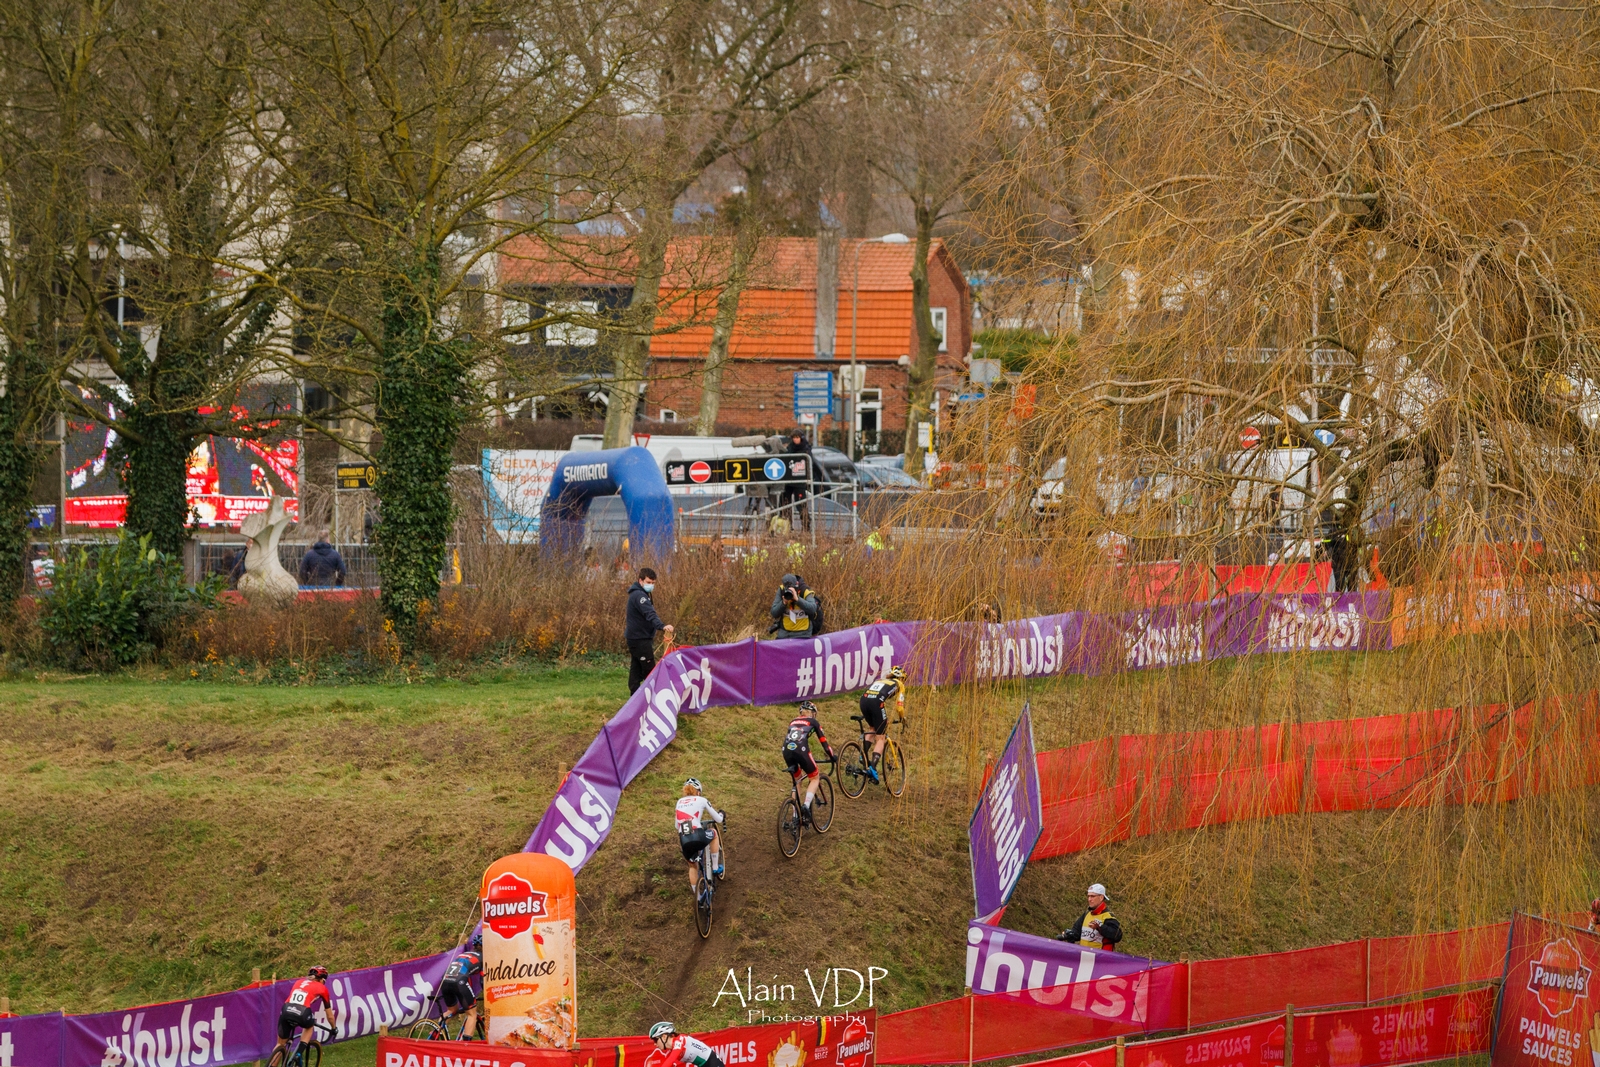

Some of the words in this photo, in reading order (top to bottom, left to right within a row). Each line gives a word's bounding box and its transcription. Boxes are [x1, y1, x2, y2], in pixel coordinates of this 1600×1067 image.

[503, 458, 537, 469] DELTA
[563, 462, 608, 483] SHIMANO
[732, 462, 743, 479] 2
[790, 730, 798, 740] 6
[682, 823, 690, 833] 5
[484, 896, 541, 918] Pauwels
[449, 965, 458, 975] 7
[1533, 966, 1585, 991] Pauwels
[292, 992, 305, 1003] 10
[1519, 1016, 1582, 1049] PAUWELS
[840, 1037, 870, 1059] Pauwels
[1521, 1038, 1573, 1067] SAUCES
